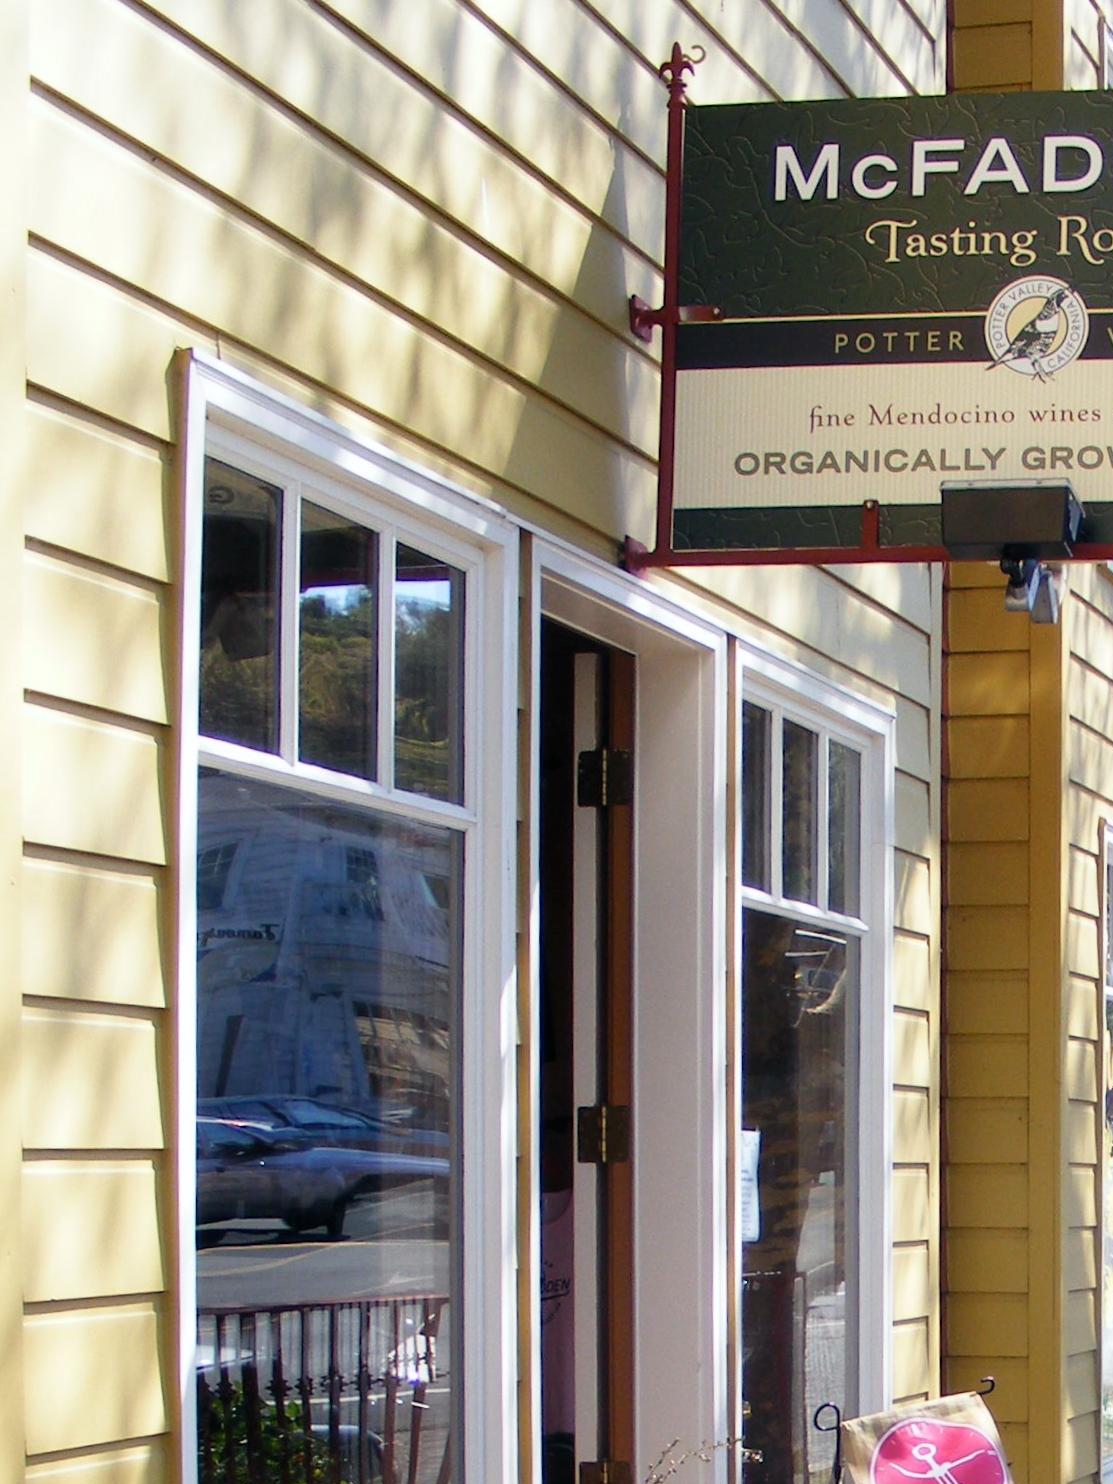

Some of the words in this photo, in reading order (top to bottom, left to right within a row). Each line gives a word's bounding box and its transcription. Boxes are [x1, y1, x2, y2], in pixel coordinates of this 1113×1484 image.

[864, 218, 1038, 268] Tasting
[834, 330, 966, 353] POTTER
[808, 405, 856, 434] fine
[867, 402, 1016, 429] Mendocino
[1028, 402, 1102, 425] wines
[733, 446, 1007, 477] ORGANICALLY
